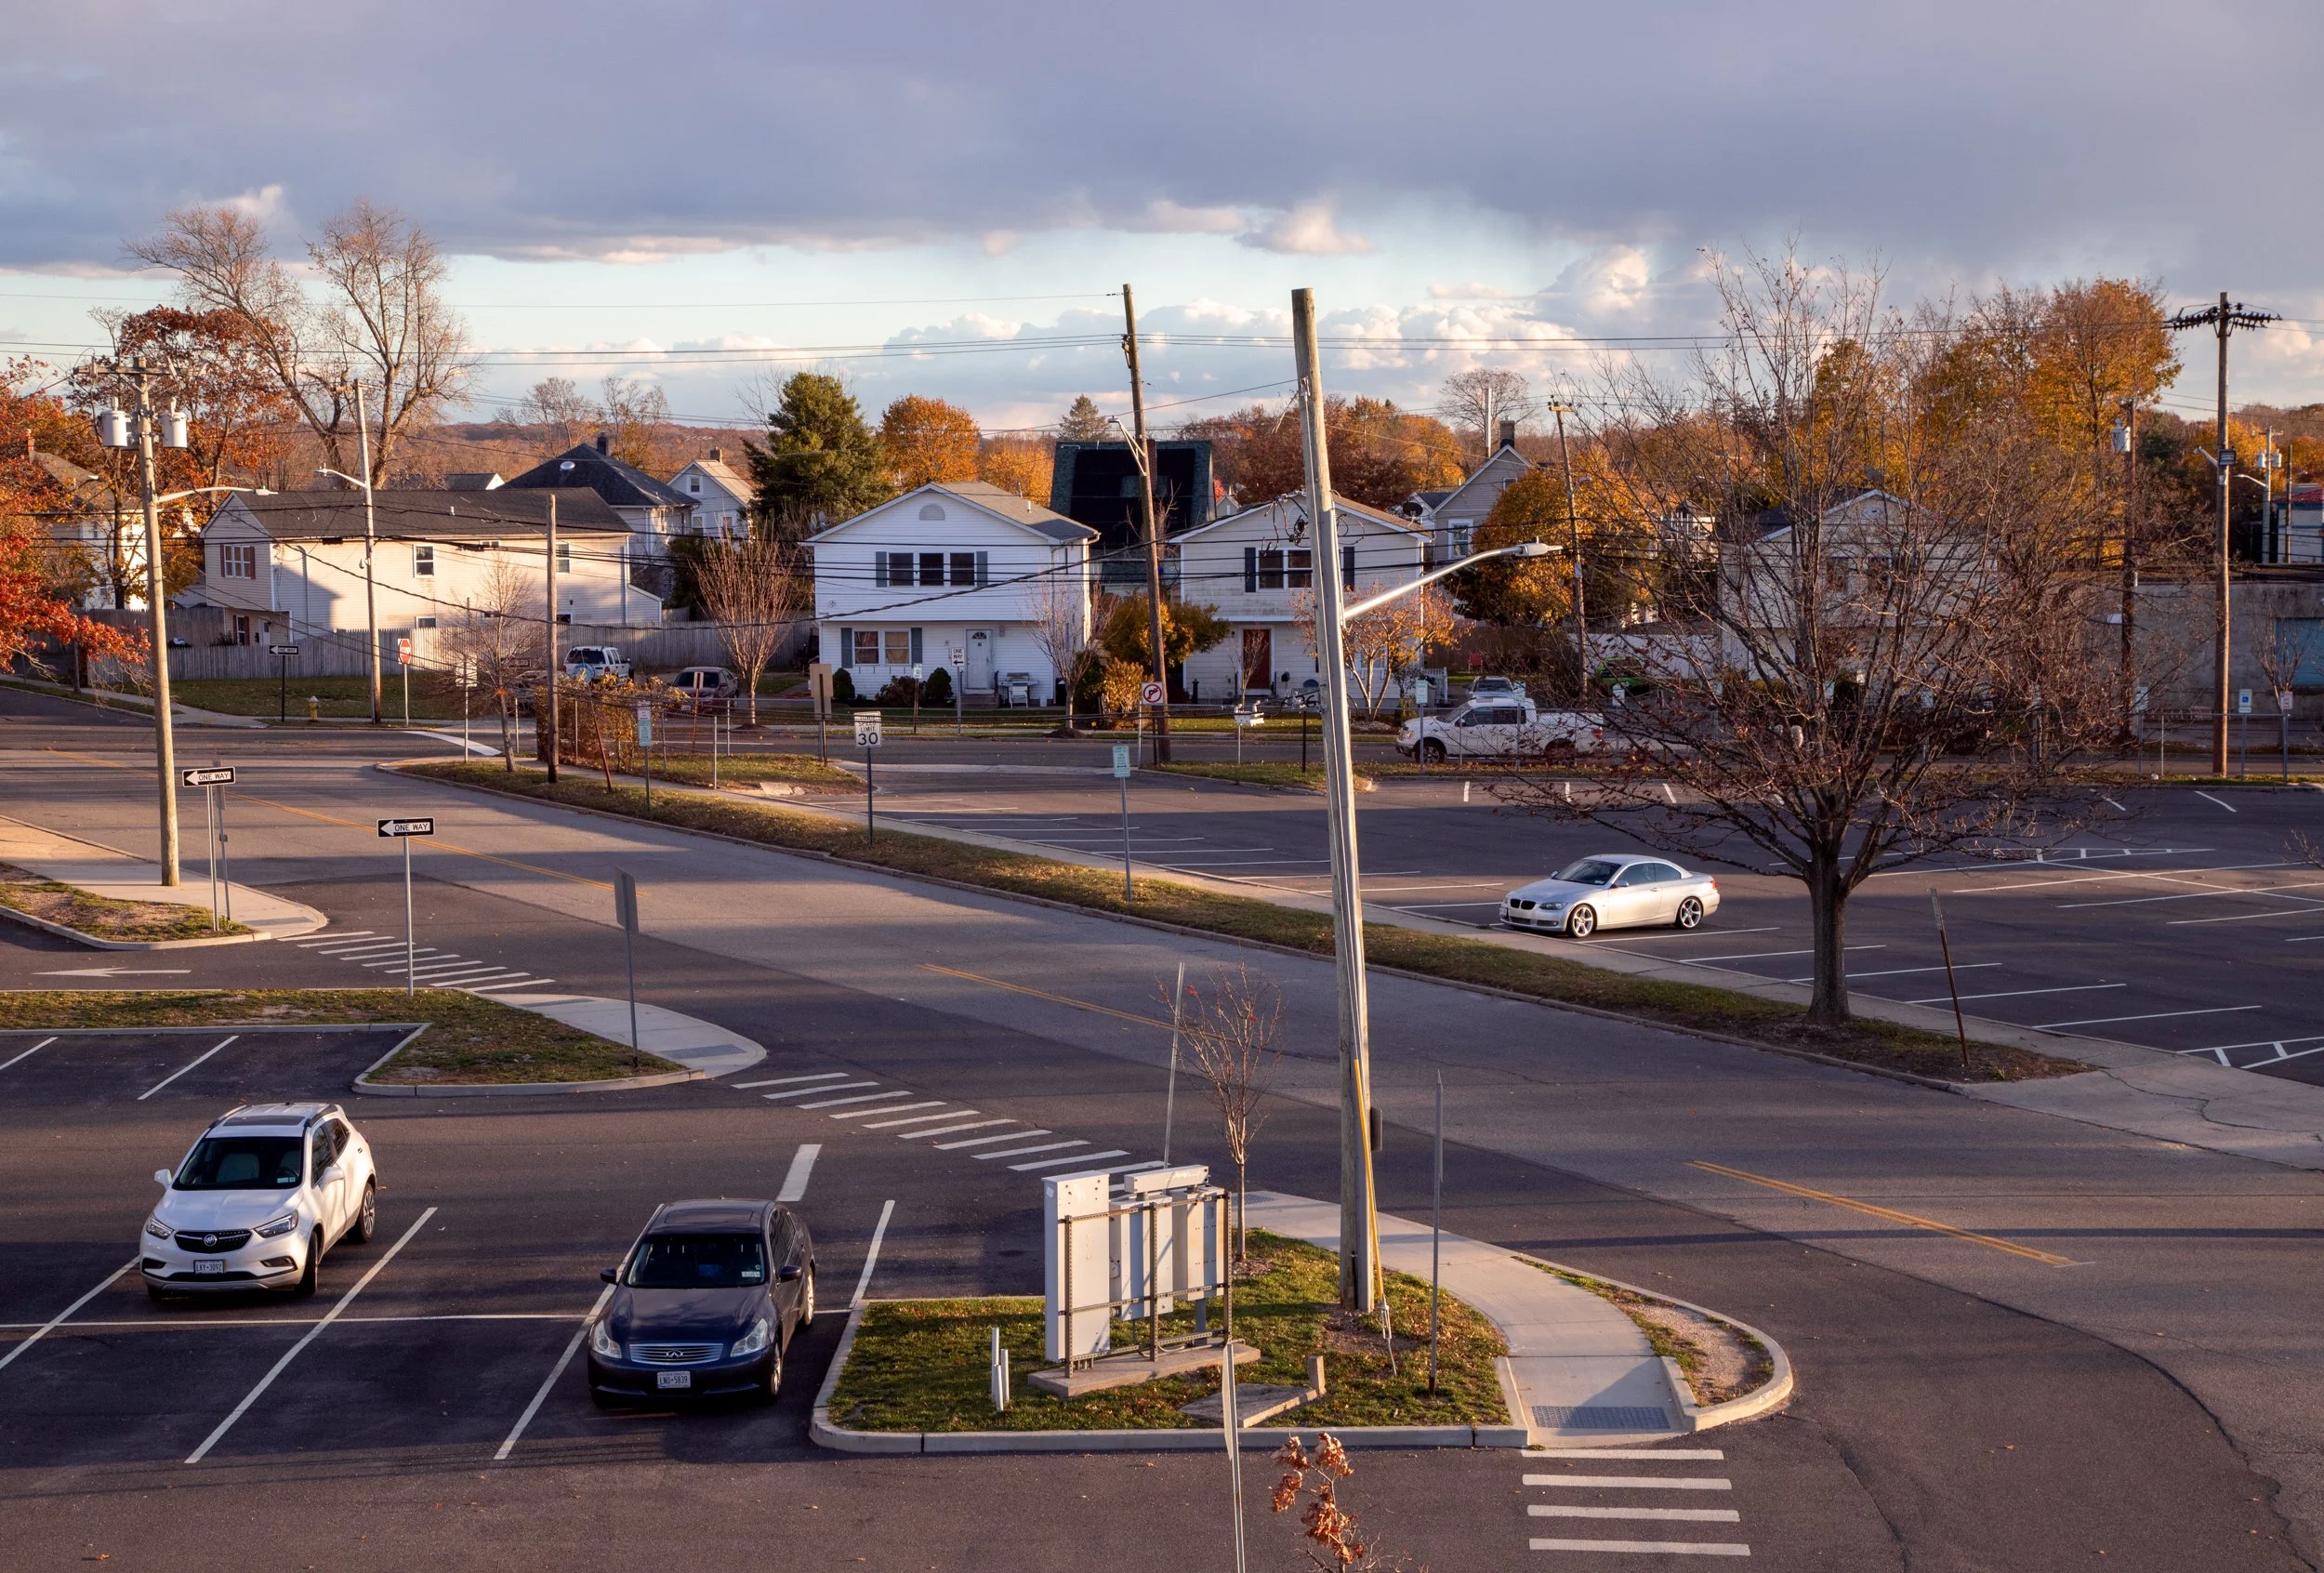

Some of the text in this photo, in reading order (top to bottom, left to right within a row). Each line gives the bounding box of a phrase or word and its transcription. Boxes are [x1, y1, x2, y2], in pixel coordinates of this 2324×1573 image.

[858, 732, 878, 746] 30
[394, 823, 428, 832] ONE WAY
